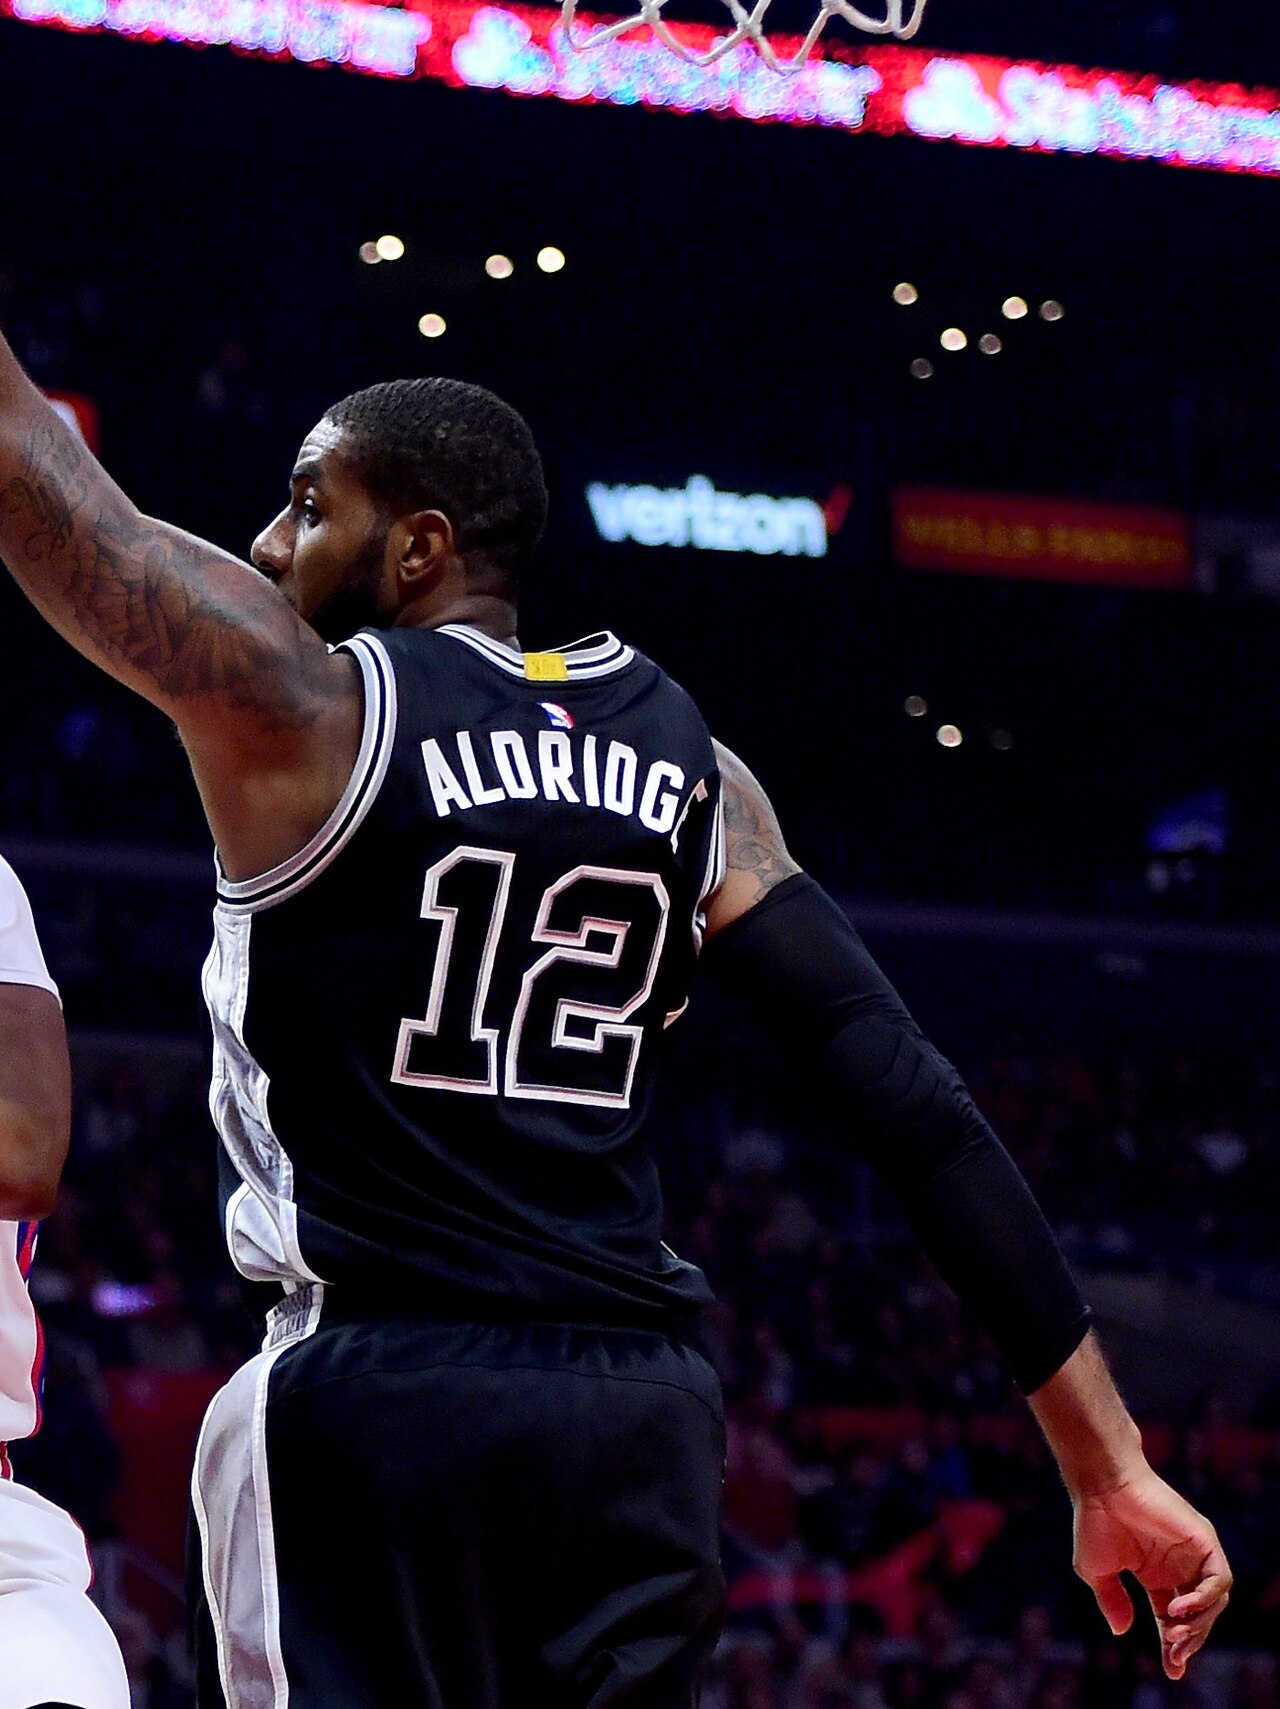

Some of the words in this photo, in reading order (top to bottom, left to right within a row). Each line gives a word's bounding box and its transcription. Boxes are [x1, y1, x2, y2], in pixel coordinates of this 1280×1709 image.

[586, 474, 827, 557] verizon
[421, 730, 708, 855] ALDRIDG
[390, 846, 670, 1109] 12
